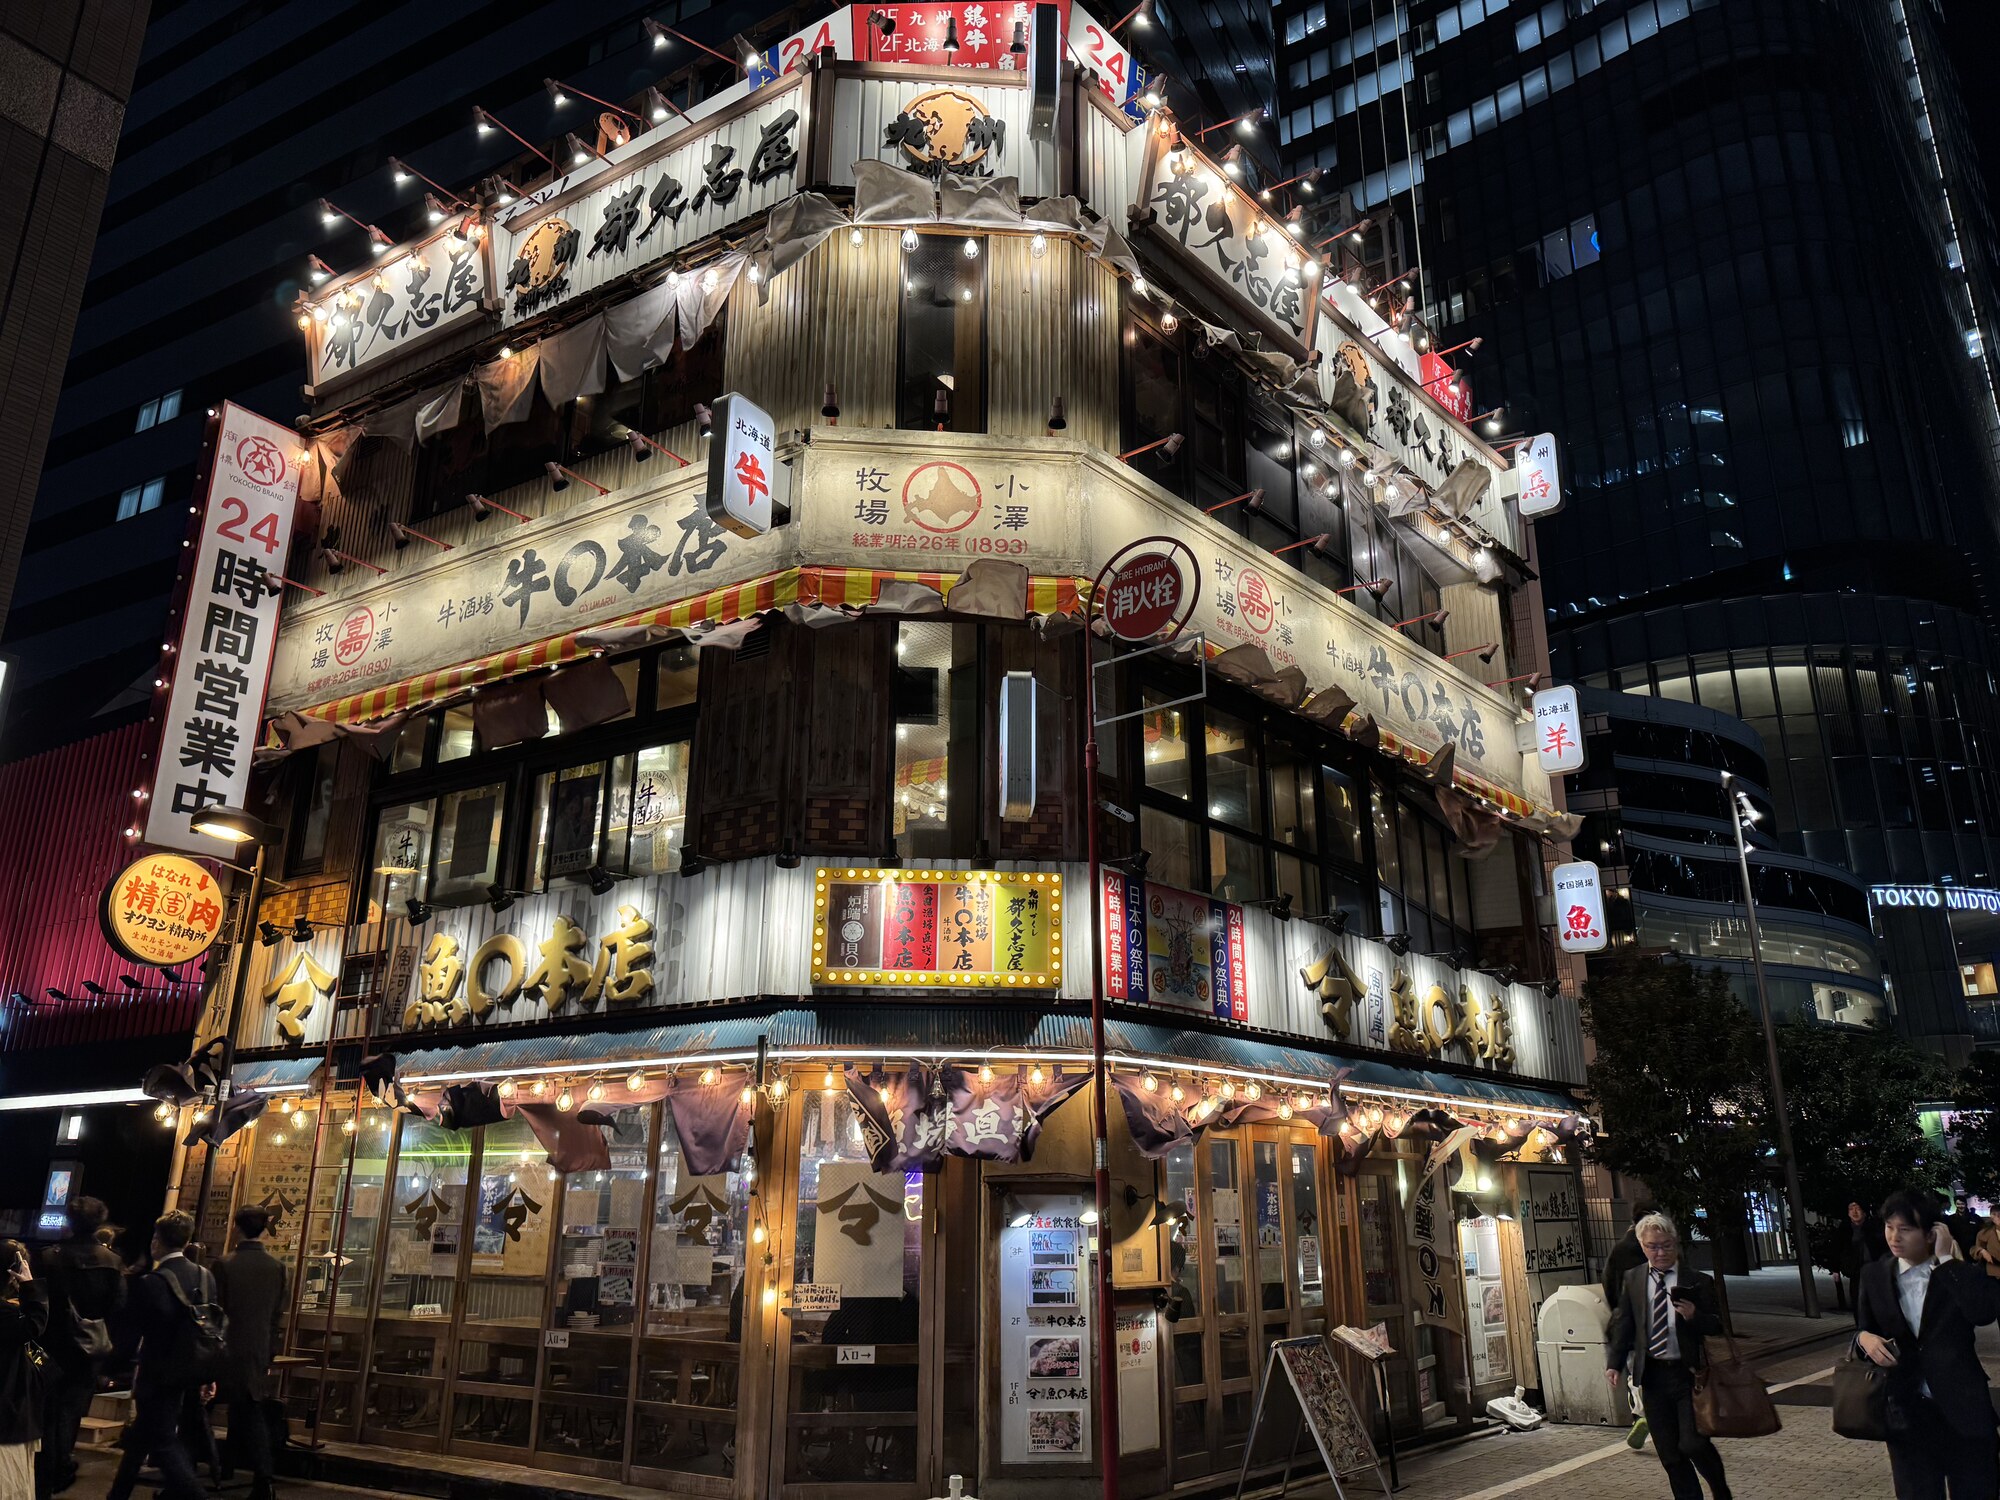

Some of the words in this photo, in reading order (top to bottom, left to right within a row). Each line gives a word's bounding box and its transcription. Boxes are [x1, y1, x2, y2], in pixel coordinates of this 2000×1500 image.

[909, 11, 951, 27] 九州
[784, 22, 835, 75] 24
[881, 34, 904, 52] 2F
[905, 37, 948, 53] 北海
[1086, 25, 1125, 84] 24
[883, 112, 1006, 157] 九州
[587, 109, 799, 260] 都久志屋
[1150, 160, 1308, 337] 都久志屋
[320, 236, 485, 372] 都久志屋
[736, 417, 771, 452] 北海道
[228, 473, 262, 493] YOKOCHO
[262, 488, 285, 502] BRAND
[734, 451, 769, 507] 牛
[853, 466, 893, 526] 牧場
[1521, 468, 1551, 501] 馬
[994, 473, 1030, 532] 小澤
[1117, 569, 1134, 582] FIRE
[1134, 559, 1168, 577] HYDRANT
[1214, 557, 1237, 618] 牧場
[437, 590, 495, 630] 牛酒場
[1112, 572, 1176, 620] 消火栓
[1239, 574, 1271, 621] 嘉
[337, 614, 371, 658] 嘉
[372, 601, 399, 652] 小澤
[1273, 594, 1294, 647] 小澤
[310, 622, 335, 669] 牧場
[1326, 638, 1366, 681] 牛酒場
[1537, 701, 1572, 717] 北海道
[1542, 723, 1576, 760] 羊
[150, 864, 192, 888] はなれ
[1556, 877, 1595, 891] 全国漁場
[1871, 888, 1940, 907] TOKYO
[122, 909, 208, 946] オクヨシ精肉所
[1004, 896, 1027, 972] 都久志屋
[1028, 888, 1040, 937] 九州づくし
[1562, 904, 1601, 941] 魚
[131, 931, 190, 954] 生ホルモン串と
[1106, 875, 1124, 994] 24時間営業中
[1128, 885, 1144, 992] 日本の祭典
[1213, 907, 1229, 1008] 日本の祭典
[1229, 909, 1245, 1017] 24時間営業中
[1520, 1200, 1531, 1219] 3F
[1525, 1249, 1537, 1271] 2F
[547, 1332, 559, 1345] 入口
[1011, 1317, 1021, 1326] 2F
[841, 1350, 859, 1362] 入口
[1009, 1396, 1020, 1405] B1
[1010, 1382, 1020, 1390] 1F
